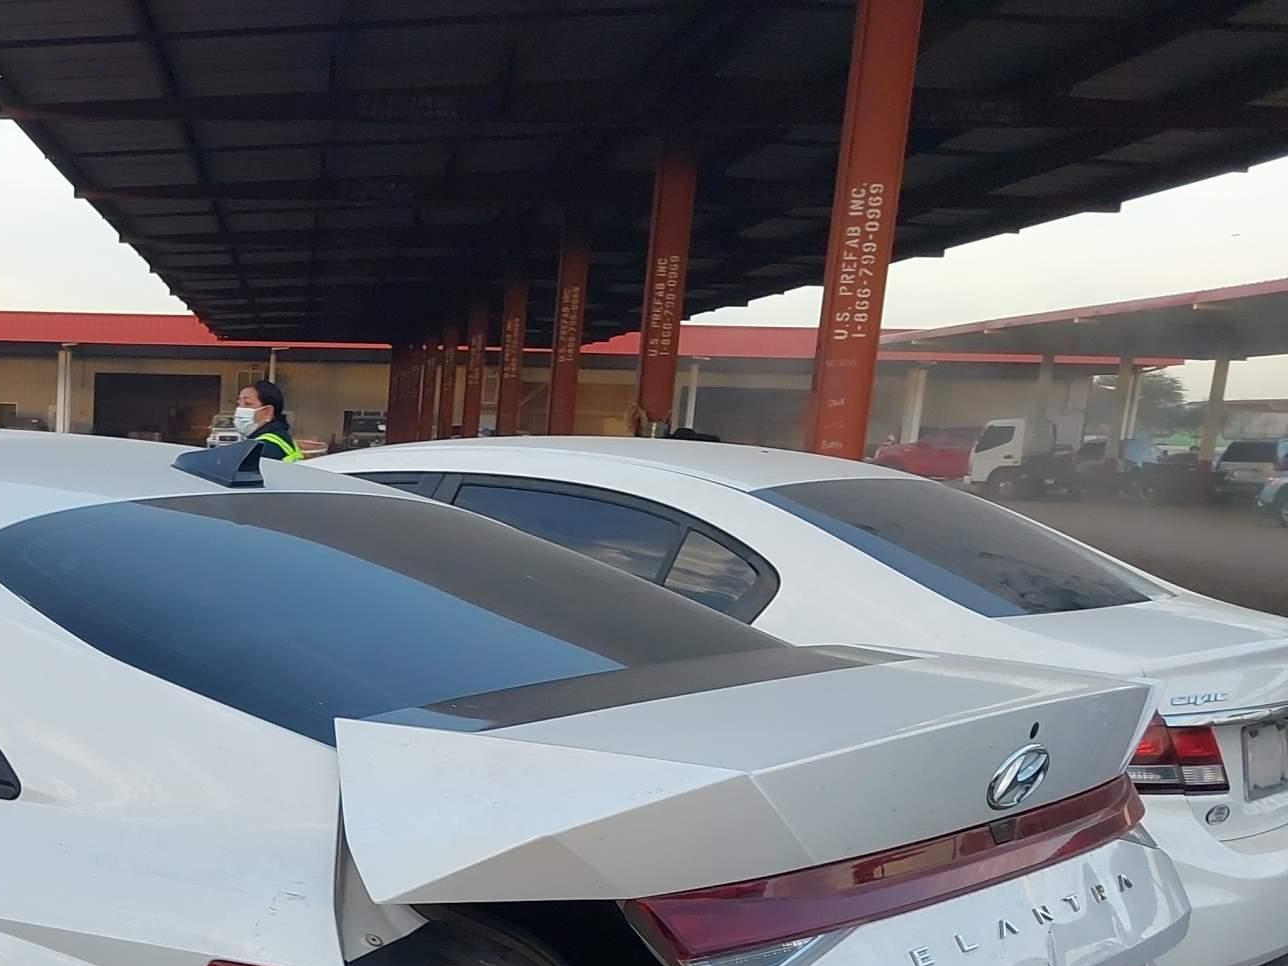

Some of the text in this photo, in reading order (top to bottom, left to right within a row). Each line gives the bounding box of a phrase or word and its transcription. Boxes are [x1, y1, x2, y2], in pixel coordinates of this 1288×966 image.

[849, 183, 867, 216] INC.
[839, 226, 861, 296] PREFAB
[853, 184, 884, 337] 1-866-799-0969
[834, 307, 852, 340] U.S.
[1170, 692, 1229, 706] CIVIC
